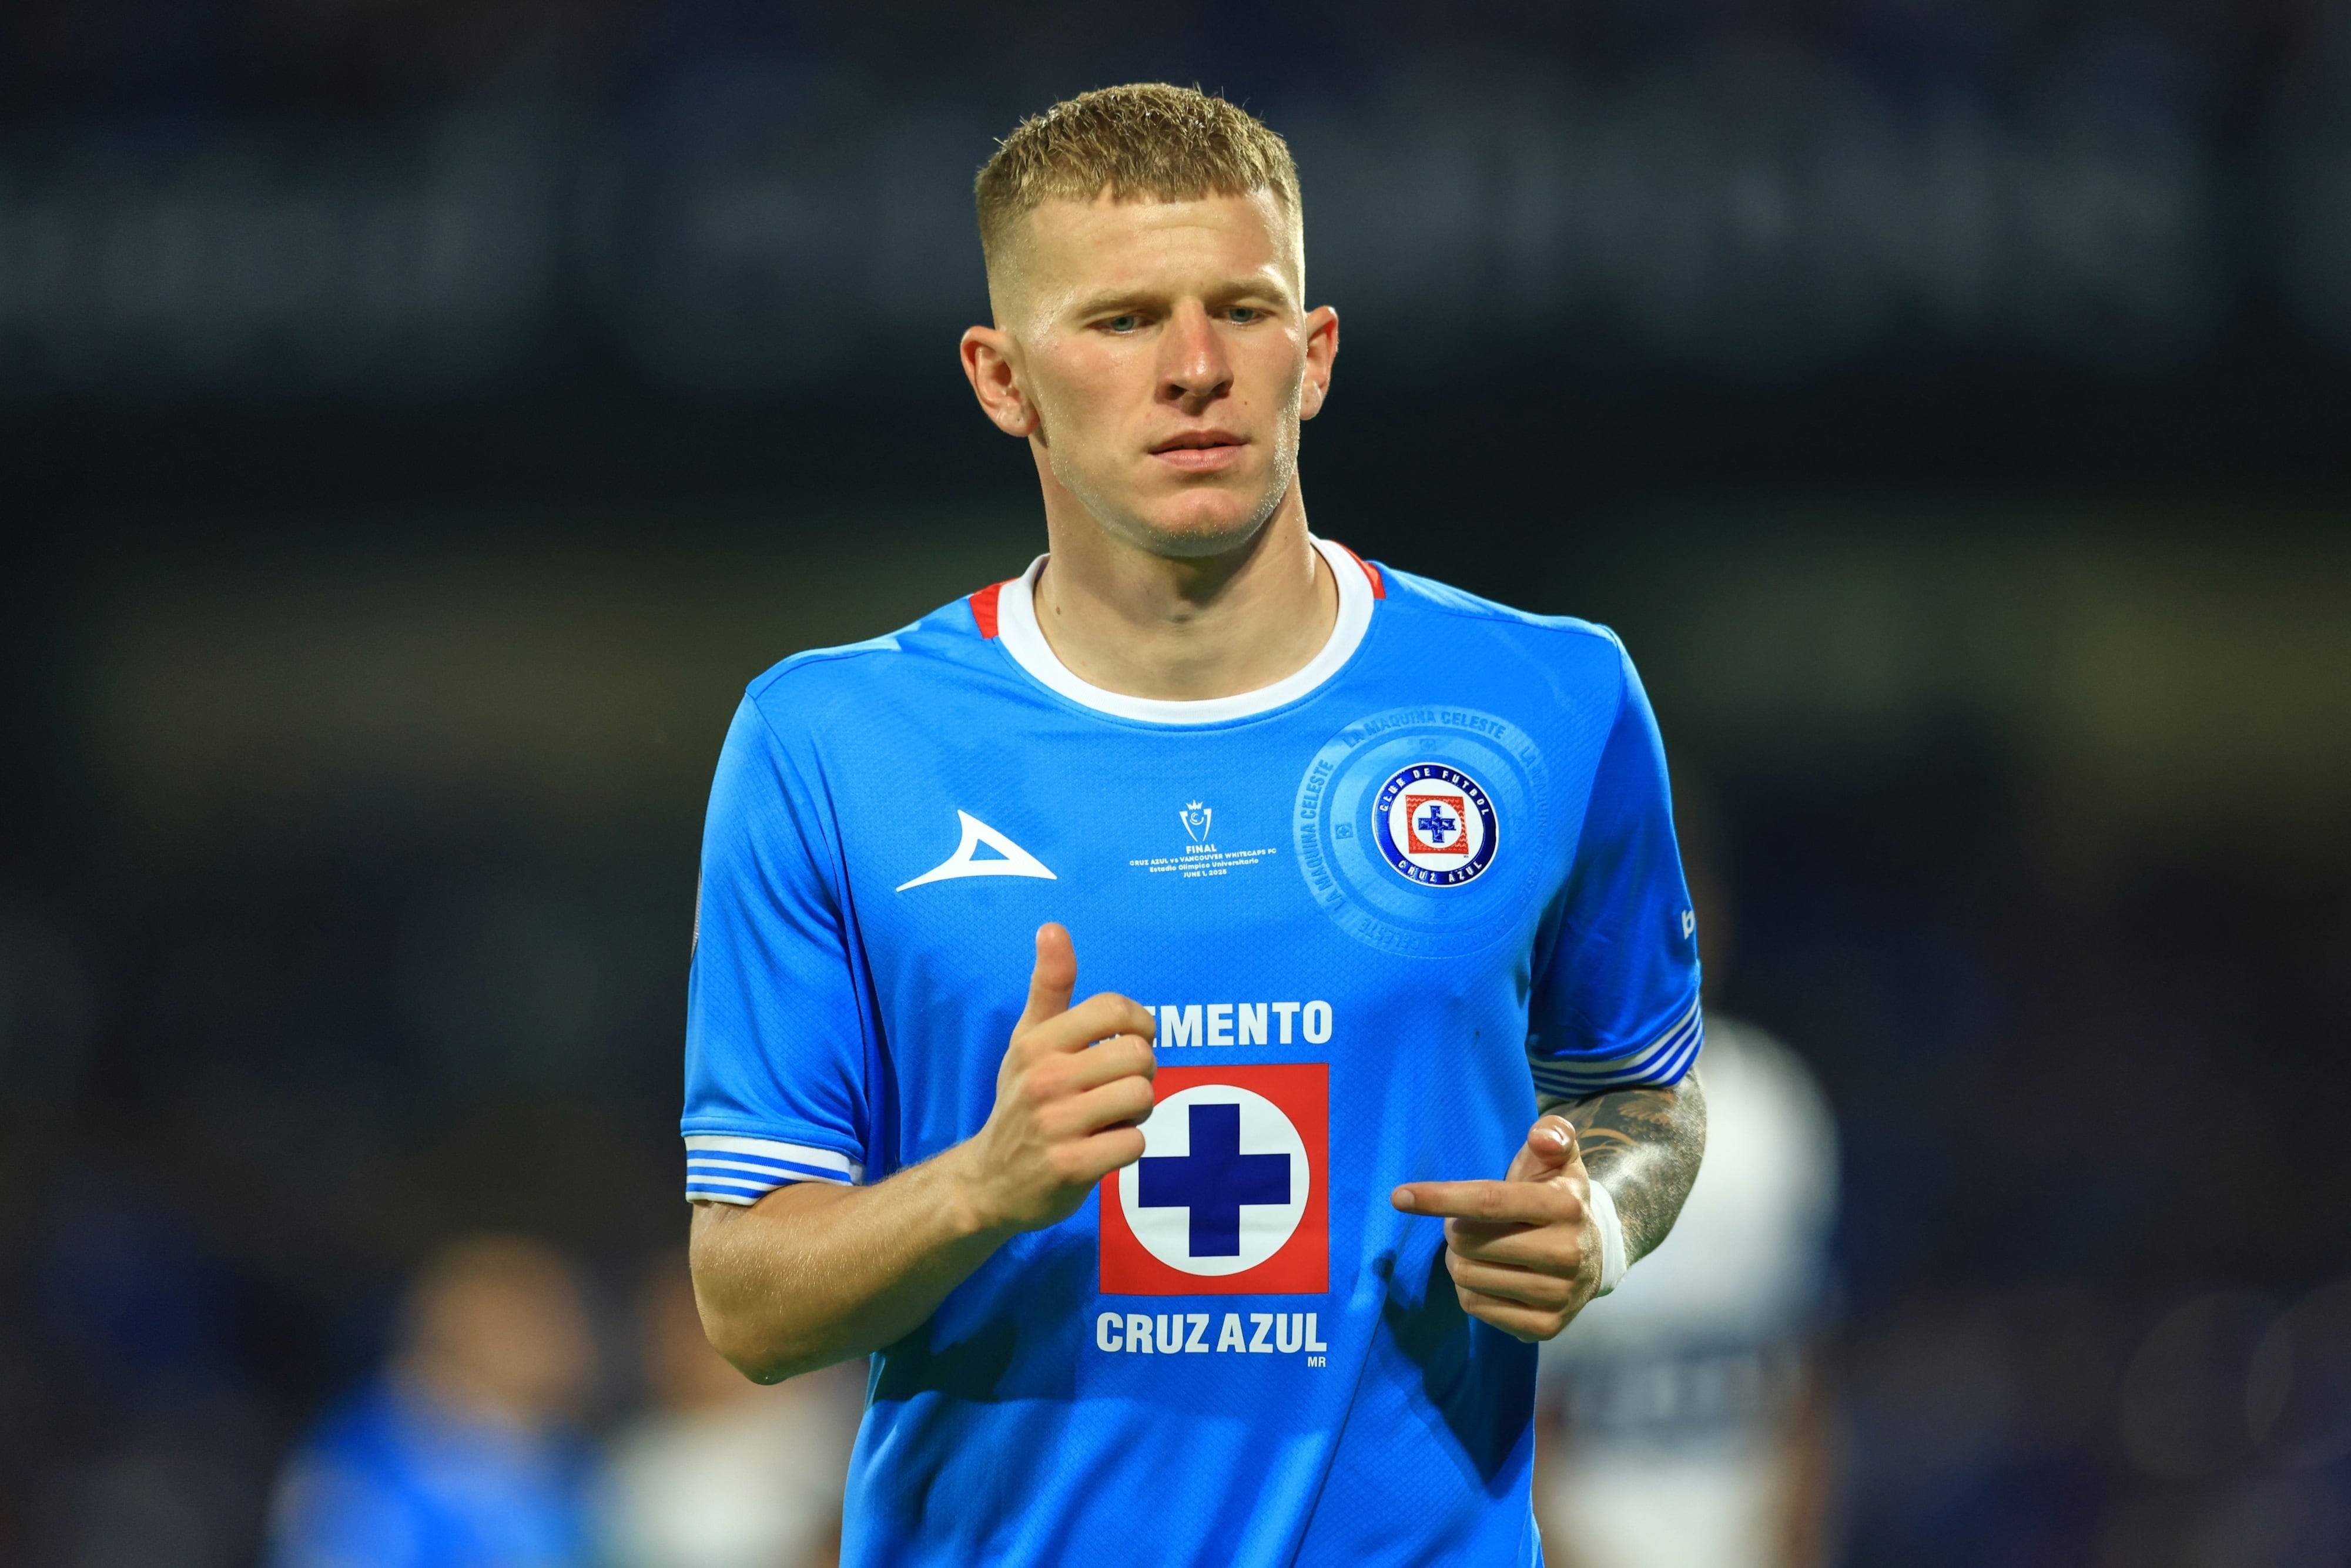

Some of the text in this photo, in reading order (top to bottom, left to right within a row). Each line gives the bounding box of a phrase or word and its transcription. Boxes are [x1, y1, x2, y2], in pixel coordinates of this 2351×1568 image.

[1441, 711, 1506, 739] CELESTE
[1379, 768, 1489, 815] CLUB DE FUTBOL
[1300, 759, 1347, 912] LA MAQUINA CELESTE
[1179, 853, 1223, 862] VANCOUVER
[1224, 849, 1266, 859] WHITECAPS
[1186, 844, 1217, 854] FINAL
[1150, 865, 1177, 873] Estadio
[1212, 857, 1259, 867] Universitario
[1398, 860, 1483, 883] CRUZ AZUL
[1100, 1000, 1333, 1048] MENTO
[1096, 1312, 1328, 1354] CRUZ AZUL
[1307, 1356, 1327, 1368] MR
